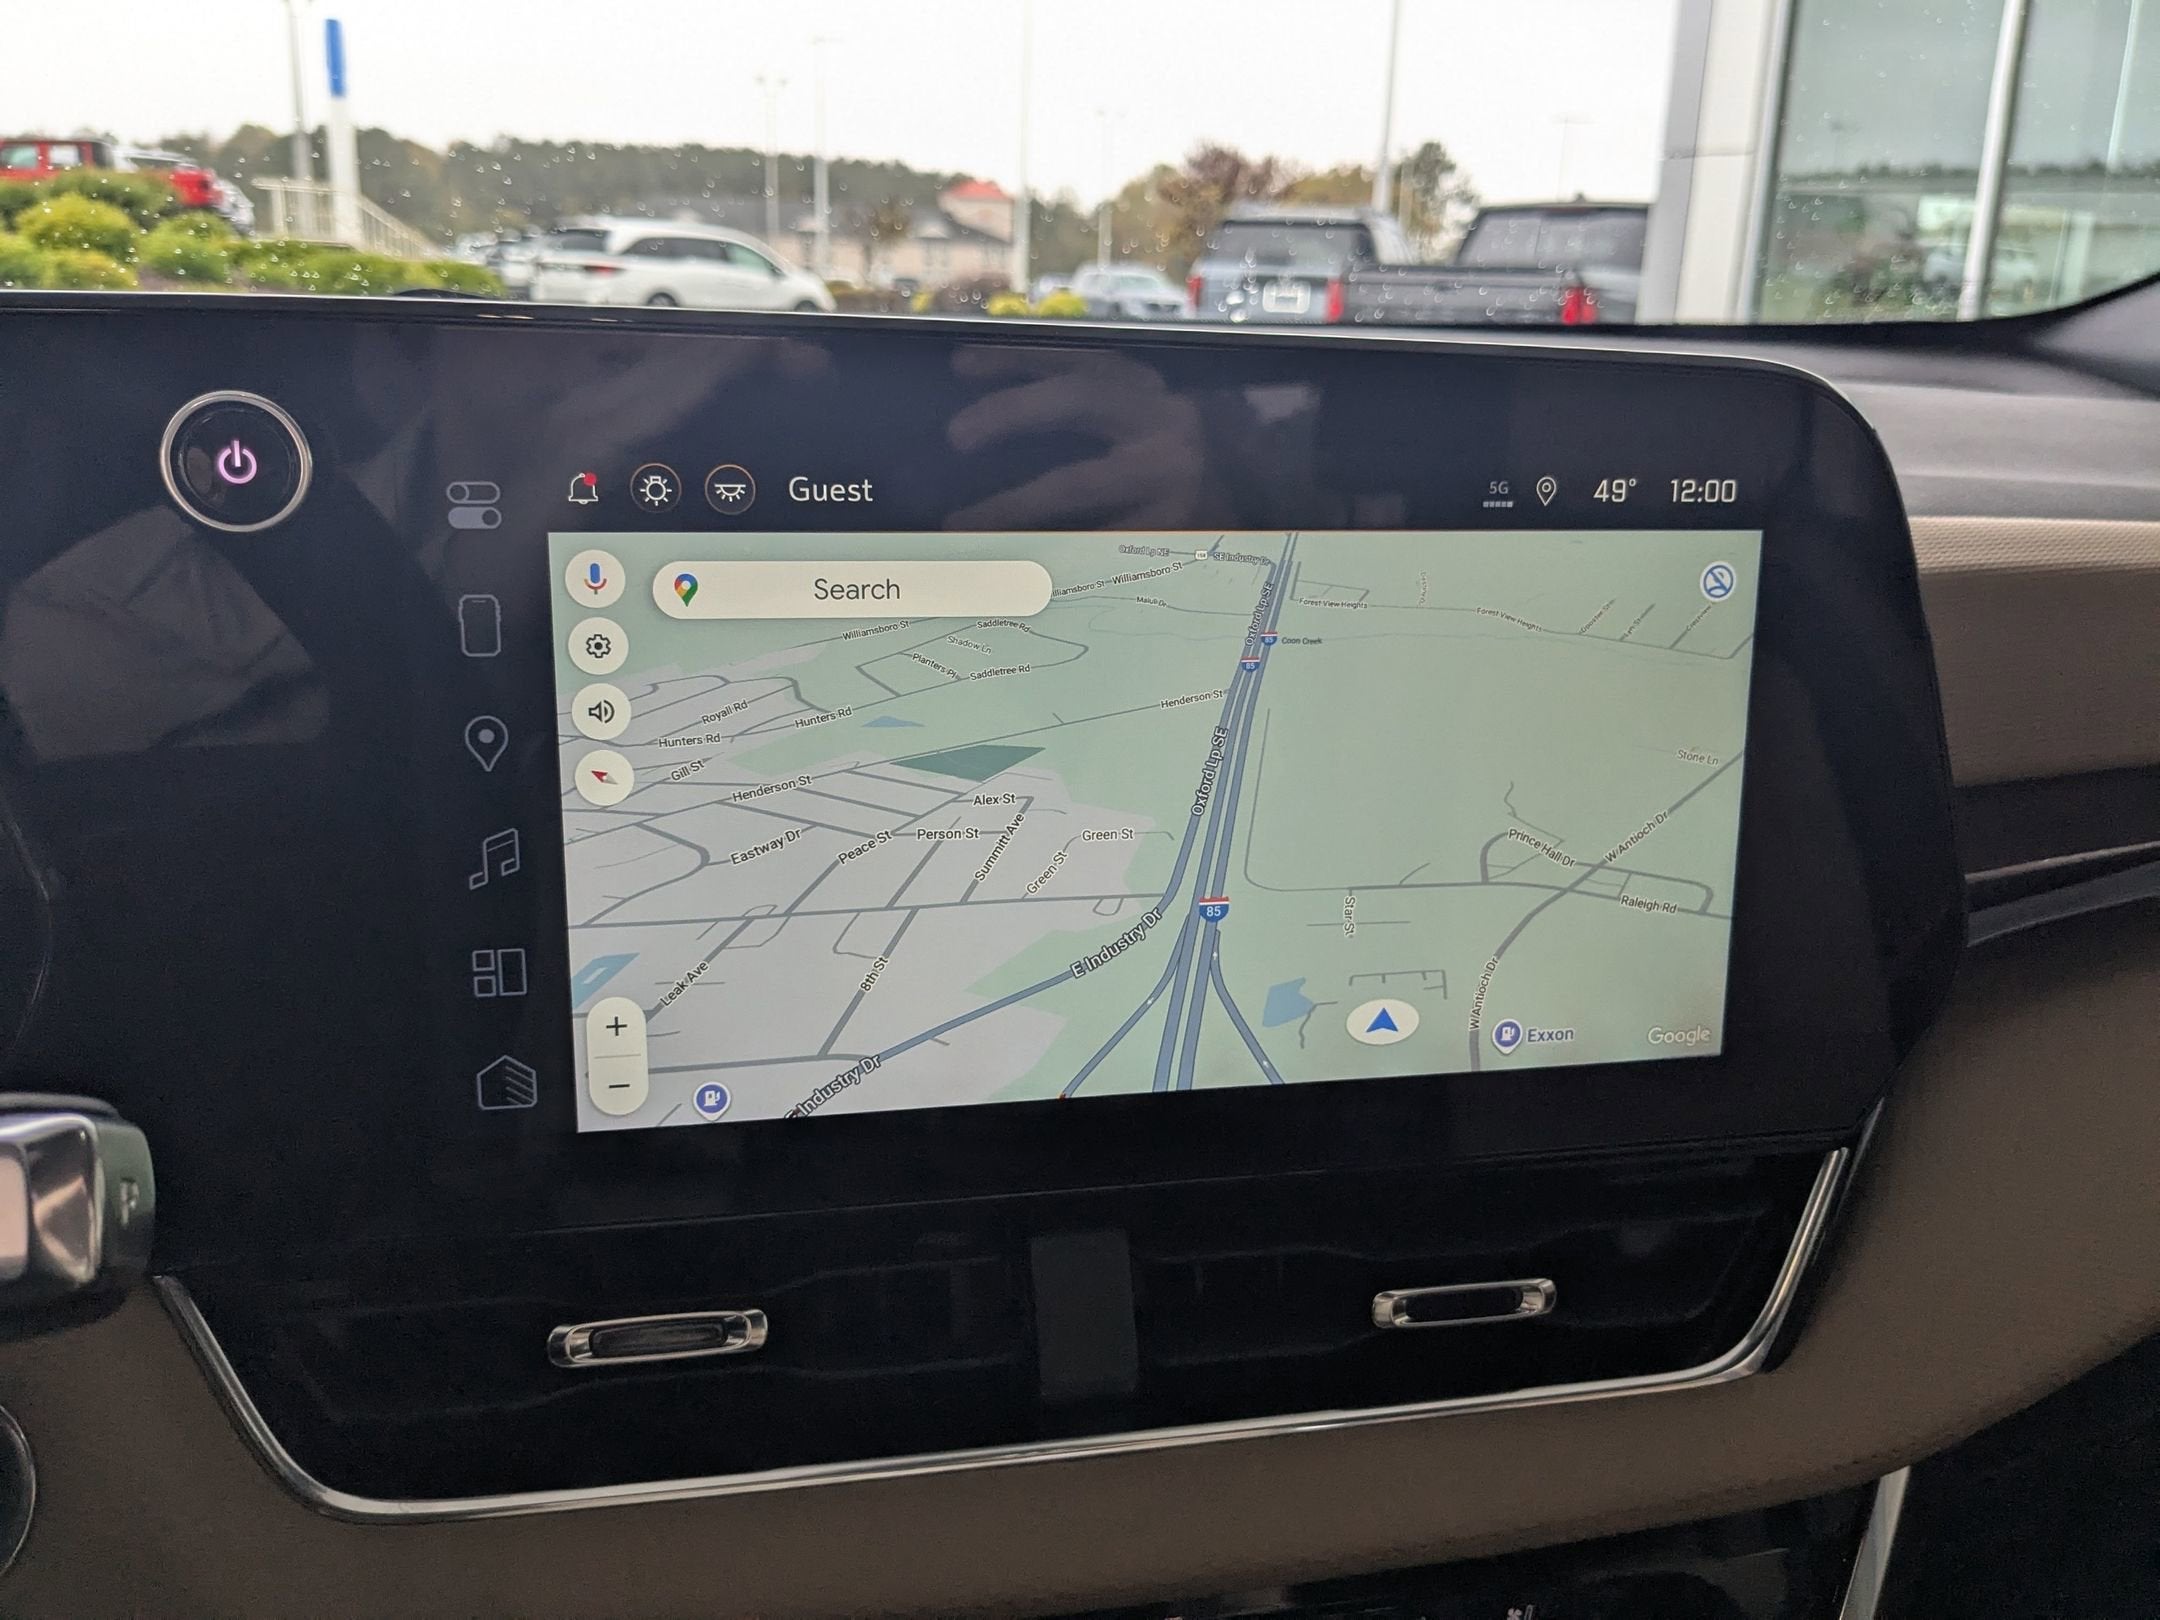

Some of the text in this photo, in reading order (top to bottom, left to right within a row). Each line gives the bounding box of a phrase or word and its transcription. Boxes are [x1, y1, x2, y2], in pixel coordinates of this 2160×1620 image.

[789, 476, 874, 502] Guest
[1489, 481, 1509, 495] 5G
[1593, 478, 1637, 503] 49°
[1670, 479, 1736, 503] 12:00
[1214, 551, 1225, 560] SE
[1226, 553, 1258, 566] Industry
[1112, 562, 1183, 585] Williamsboro St
[813, 577, 902, 601] Search
[1050, 580, 1105, 598] illiamsboro St
[1244, 581, 1274, 647] Oxford Lp SE
[1299, 597, 1368, 610] Forest View Heights
[1476, 607, 1500, 616] Forest
[1500, 611, 1516, 622] View
[842, 620, 910, 641] Williamsboro St
[976, 619, 1031, 633] Saddletree Rd
[947, 635, 992, 655] Shadow Ln
[1281, 636, 1323, 646] Coon Creek
[912, 652, 957, 679] Planters Pl
[969, 663, 1031, 681] Saddletree Rd
[1245, 661, 1256, 670] 85
[1160, 689, 1224, 709] Henderson St
[701, 699, 749, 725] Royall Rd
[795, 706, 853, 729] Hunters Rd
[658, 733, 721, 749] Hunters Rd
[1677, 749, 1719, 766] Stone Ln
[671, 759, 706, 782] Gill St
[1192, 725, 1228, 816] Oxford Lp SE
[732, 775, 813, 803] Henderson St
[973, 792, 1016, 806] Alex St
[916, 827, 979, 841] Person St
[1081, 828, 1134, 842] Green St
[1604, 809, 1669, 864] W Antioch Dr
[730, 828, 802, 866] Eastway Dr
[838, 829, 893, 865] Peace St
[975, 812, 1025, 882] Summitt Ave
[1508, 828, 1576, 868] Prince Hall Dr
[1026, 850, 1068, 896] Green St
[1206, 905, 1221, 917] 85
[1344, 896, 1356, 936] Star St
[1620, 895, 1677, 915] Raleigh Rd
[1070, 908, 1162, 979] E Industry Dr
[660, 960, 709, 1007] Leak Ave
[860, 956, 889, 993] 8th St
[1469, 956, 1499, 1031] W Antioch Dr
[1527, 1029, 1574, 1043] Exxon
[1647, 1026, 1711, 1047] Google
[797, 1054, 881, 1117] Industry Dr
[120, 1179, 140, 1226] P
